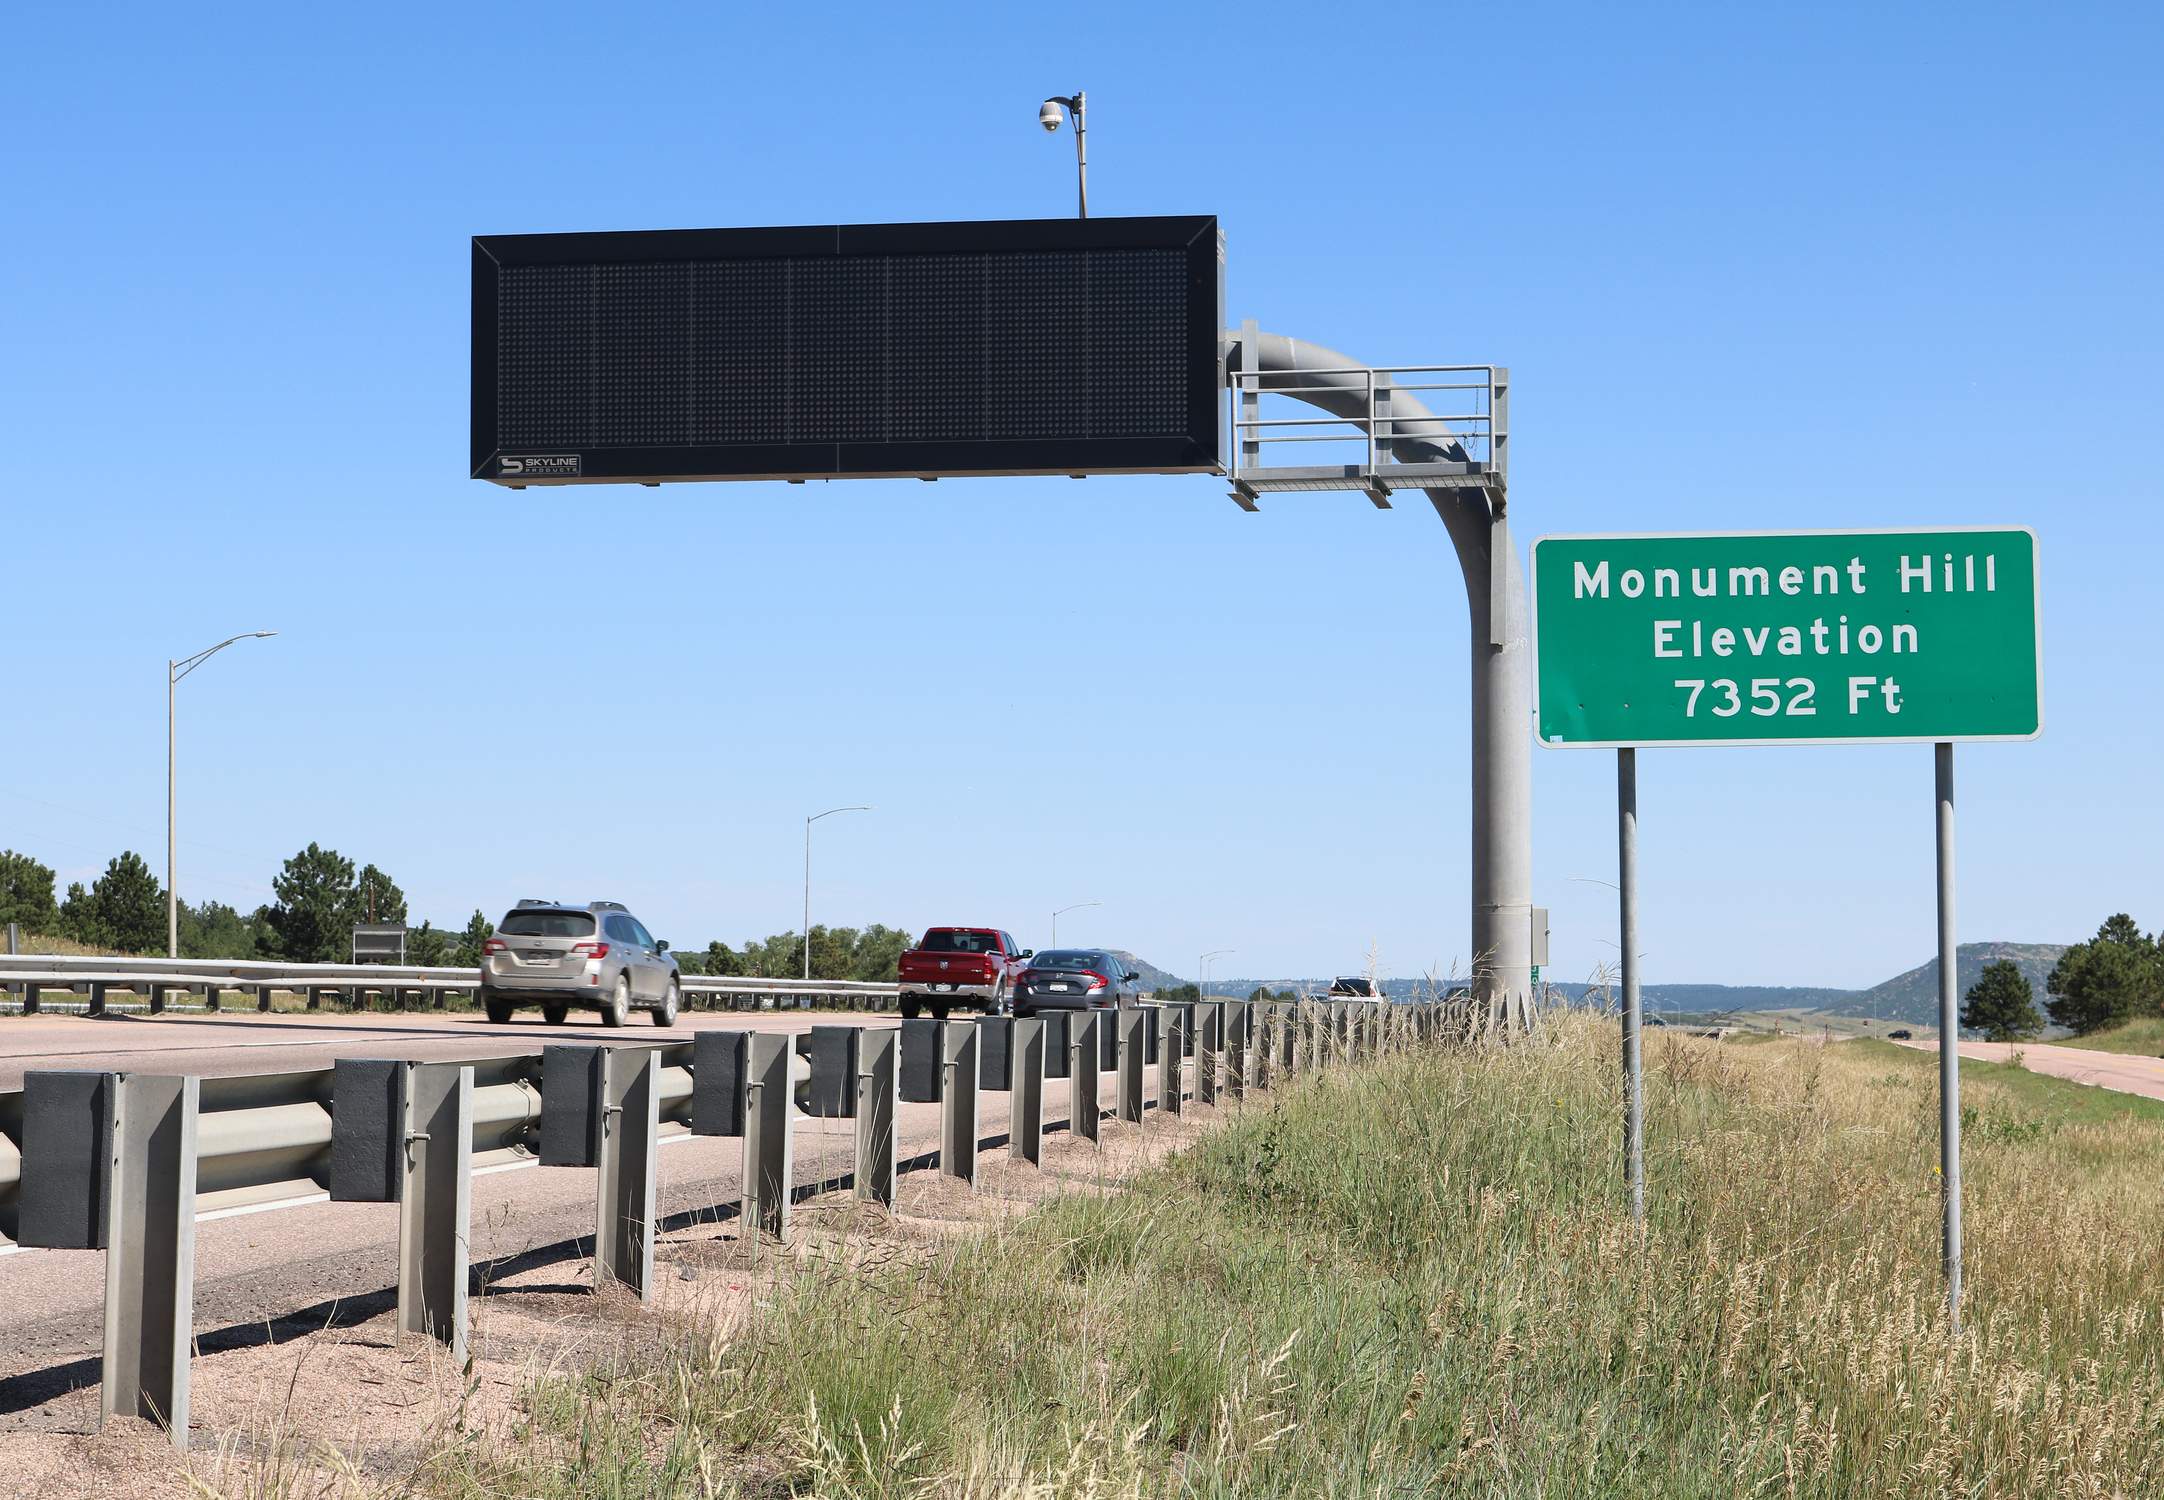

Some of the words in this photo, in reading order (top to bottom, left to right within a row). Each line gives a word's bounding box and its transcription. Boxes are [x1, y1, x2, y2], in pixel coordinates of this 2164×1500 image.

[525, 457, 578, 467] SKYLINE
[1574, 555, 1866, 599] Monument
[1900, 552, 1997, 593] Hill
[1653, 614, 1919, 658] Elevation
[1673, 677, 1817, 718] 7352
[1848, 675, 1903, 716] Ft
